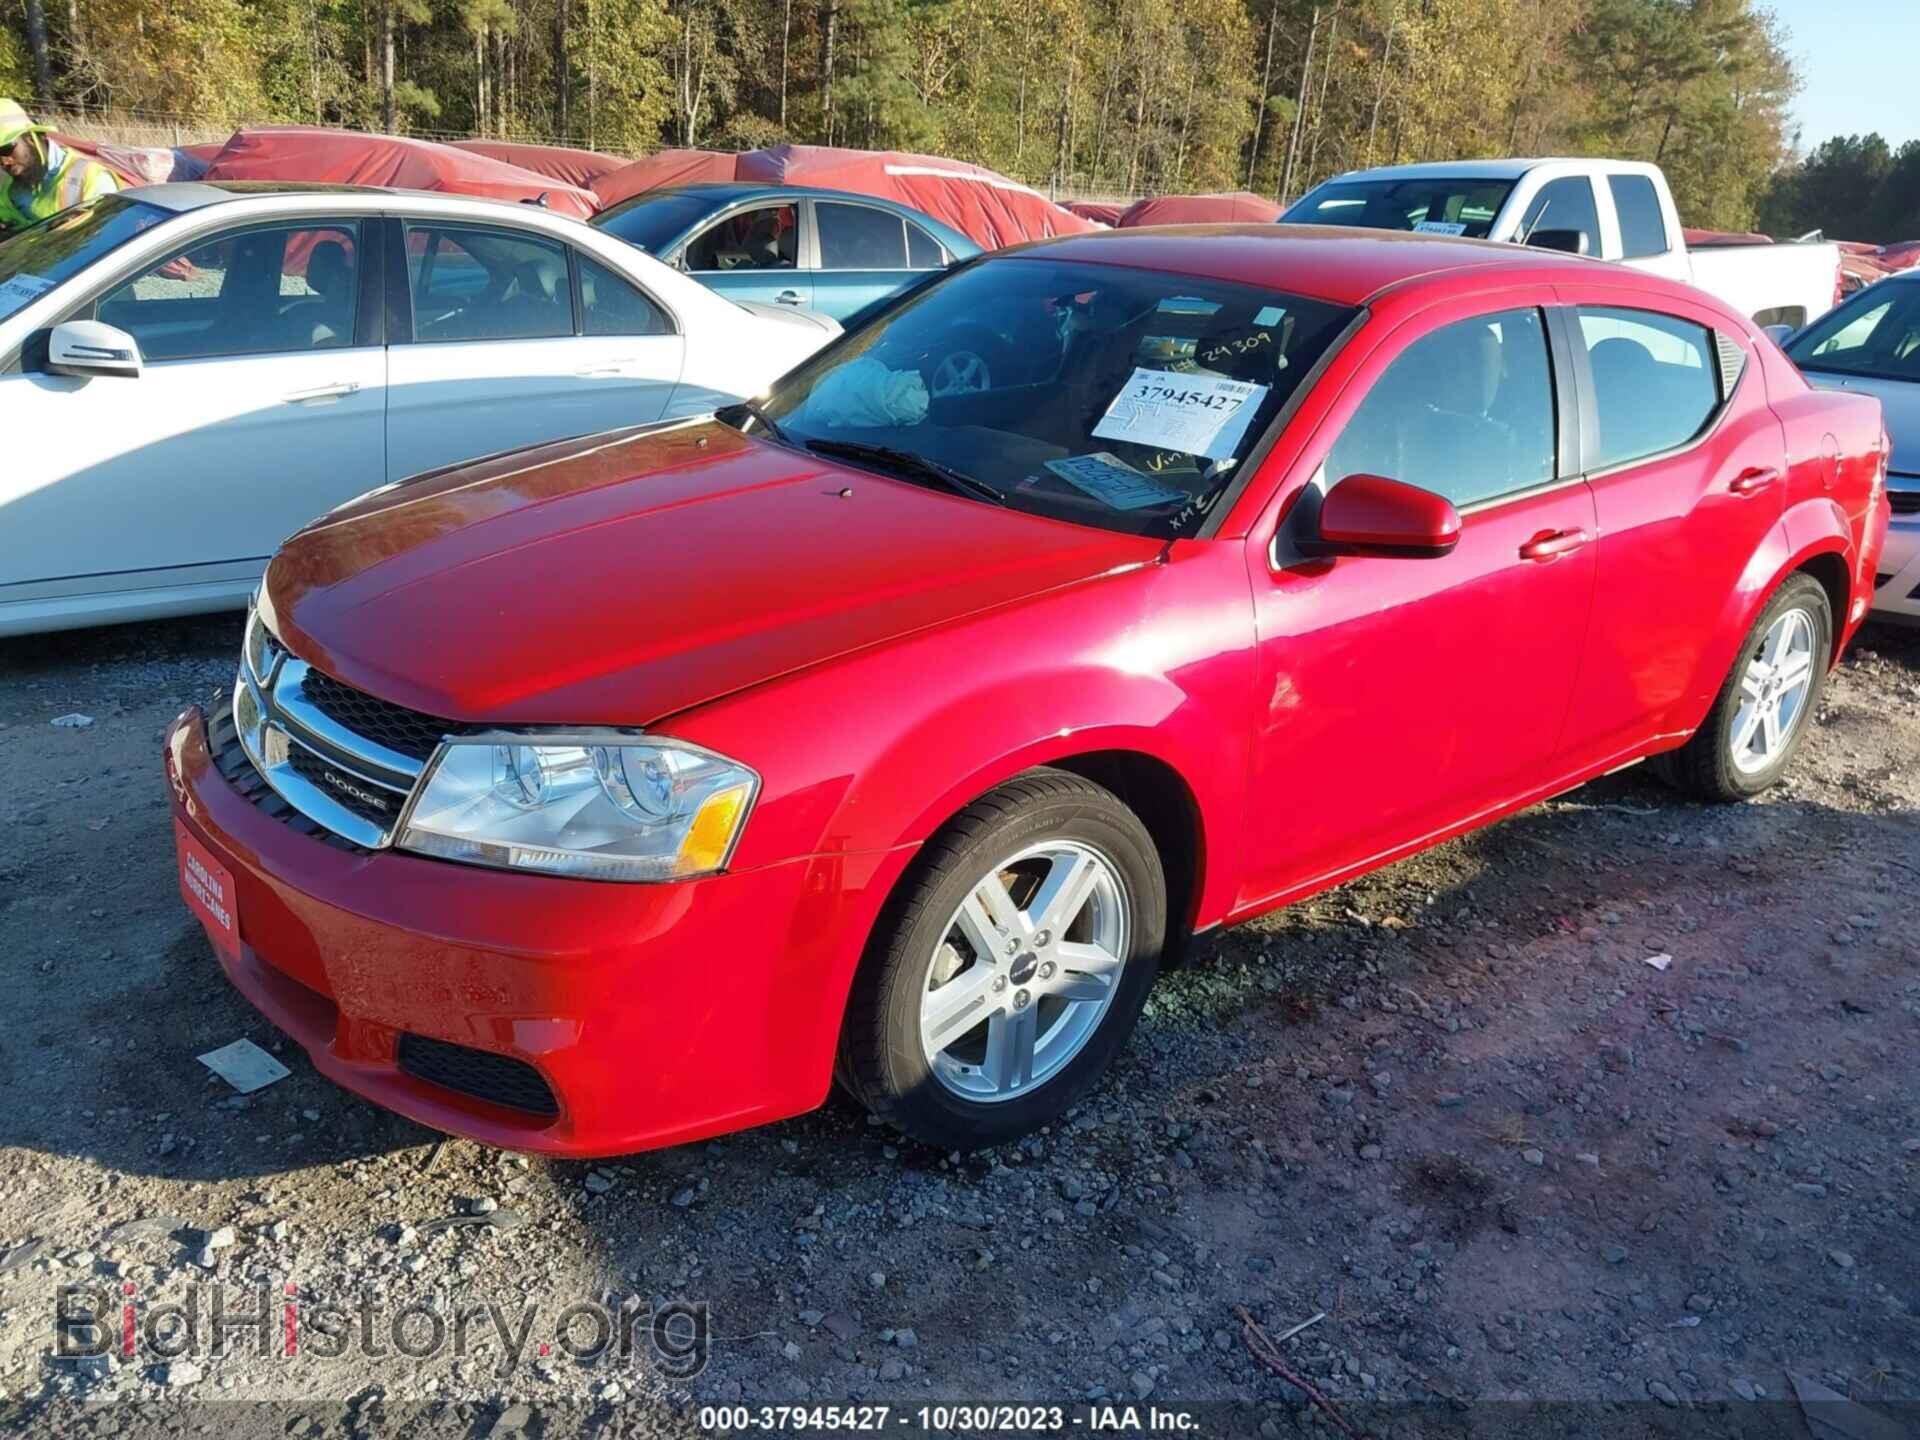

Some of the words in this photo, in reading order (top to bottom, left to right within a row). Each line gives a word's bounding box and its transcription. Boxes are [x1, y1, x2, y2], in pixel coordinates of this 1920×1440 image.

[1132, 385, 1243, 413] 37945427
[323, 771, 388, 810] DODGE
[186, 851, 224, 903] CAROLINA
